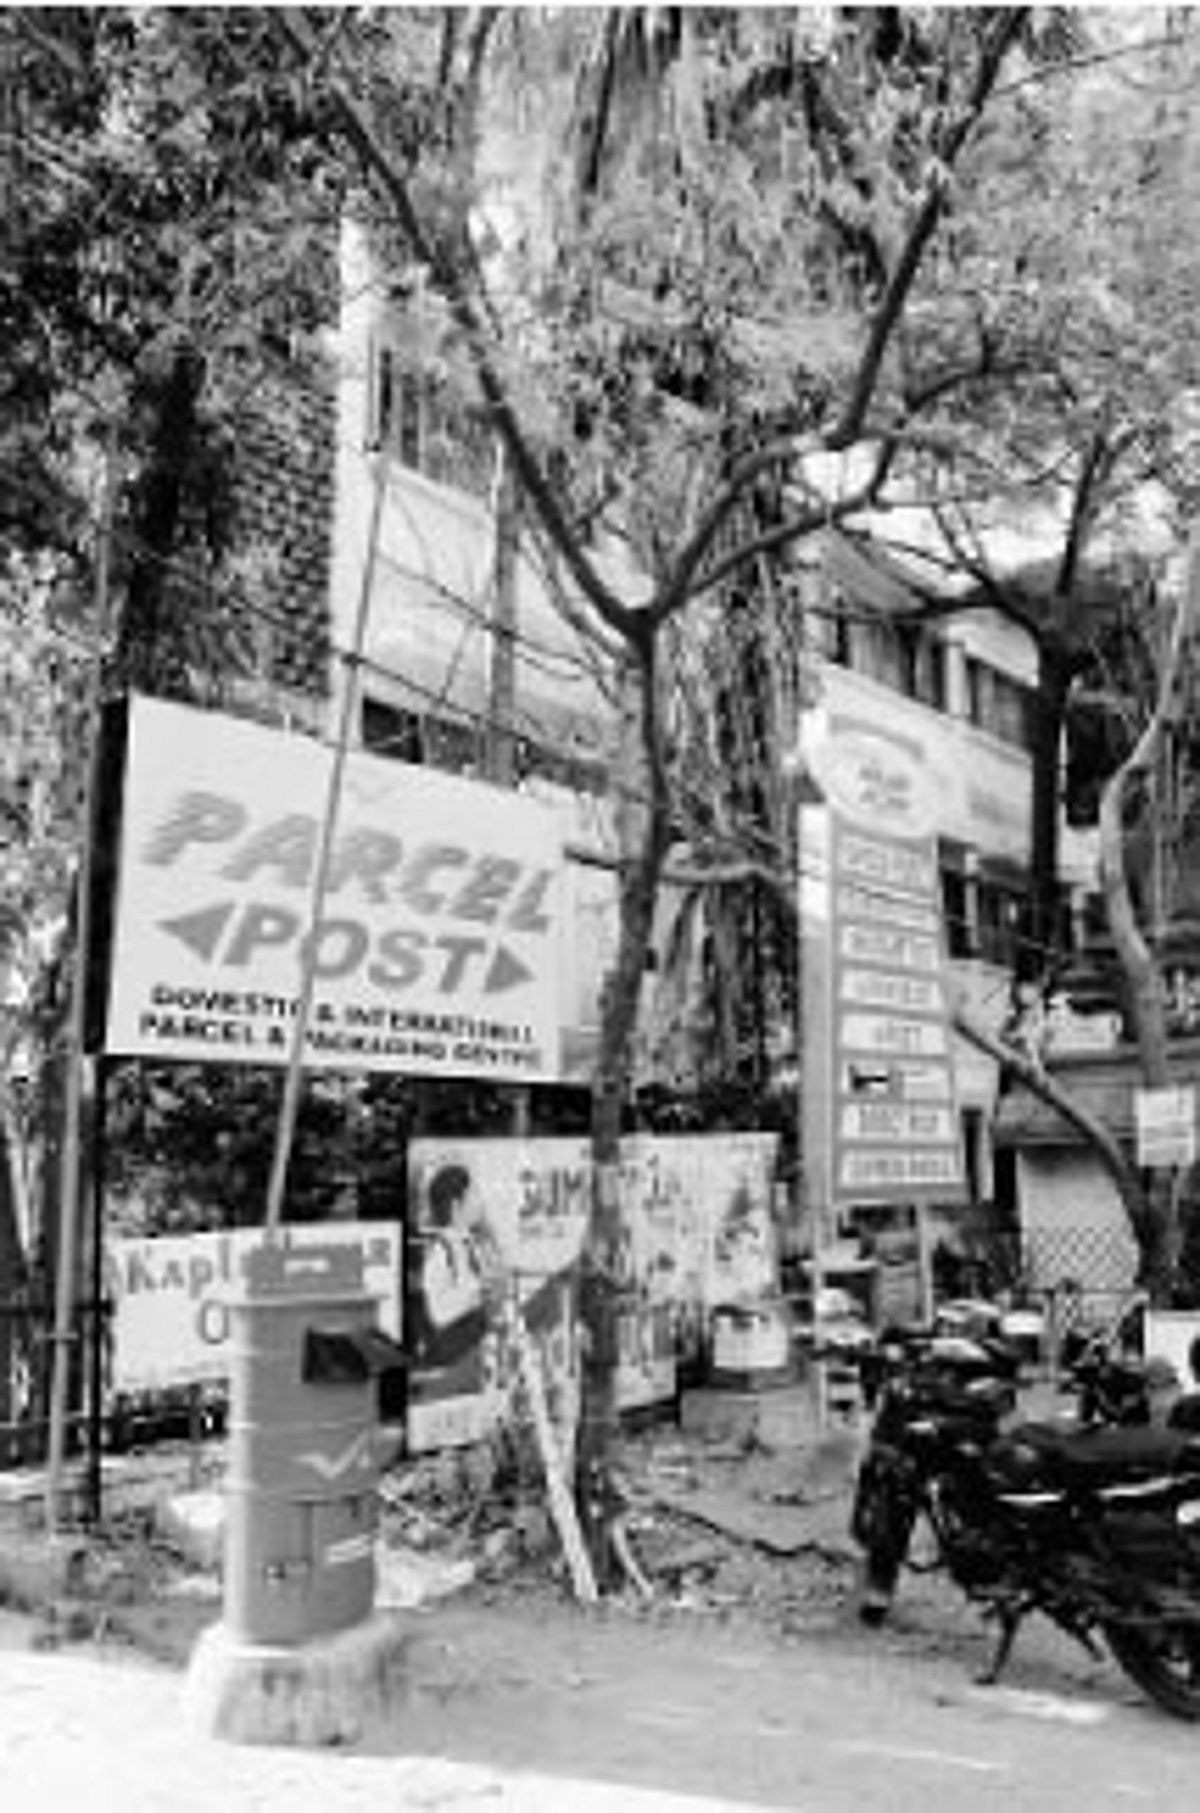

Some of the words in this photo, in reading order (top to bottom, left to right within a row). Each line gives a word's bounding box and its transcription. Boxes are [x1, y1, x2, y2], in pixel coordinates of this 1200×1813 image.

[141, 790, 556, 933] PARCEL
[222, 903, 487, 995] POST
[139, 1013, 254, 1046] PARCEL
[267, 1026, 285, 1047] &
